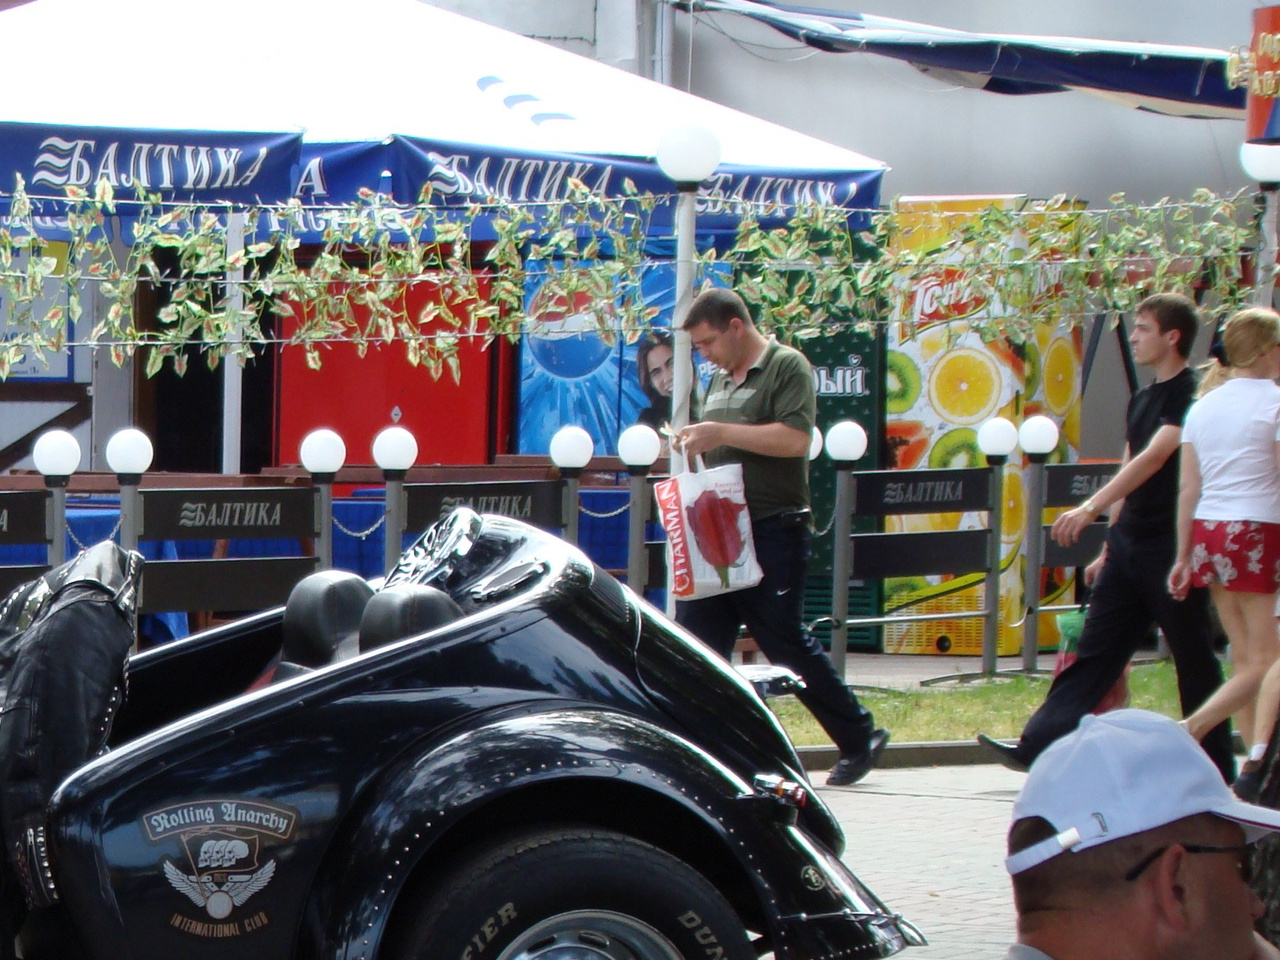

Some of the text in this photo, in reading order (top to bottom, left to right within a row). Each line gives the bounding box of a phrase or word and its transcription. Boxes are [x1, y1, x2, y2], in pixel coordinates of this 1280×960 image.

[69, 138, 268, 191] БАЛТИКА
[895, 480, 963, 501] БАЛТИКА
[194, 502, 281, 526] БАЛТИКА
[661, 480, 691, 593] CHARMAN
[151, 802, 288, 833] Rolling Anarchy
[170, 911, 269, 937] INTERNATIONAL CLUB
